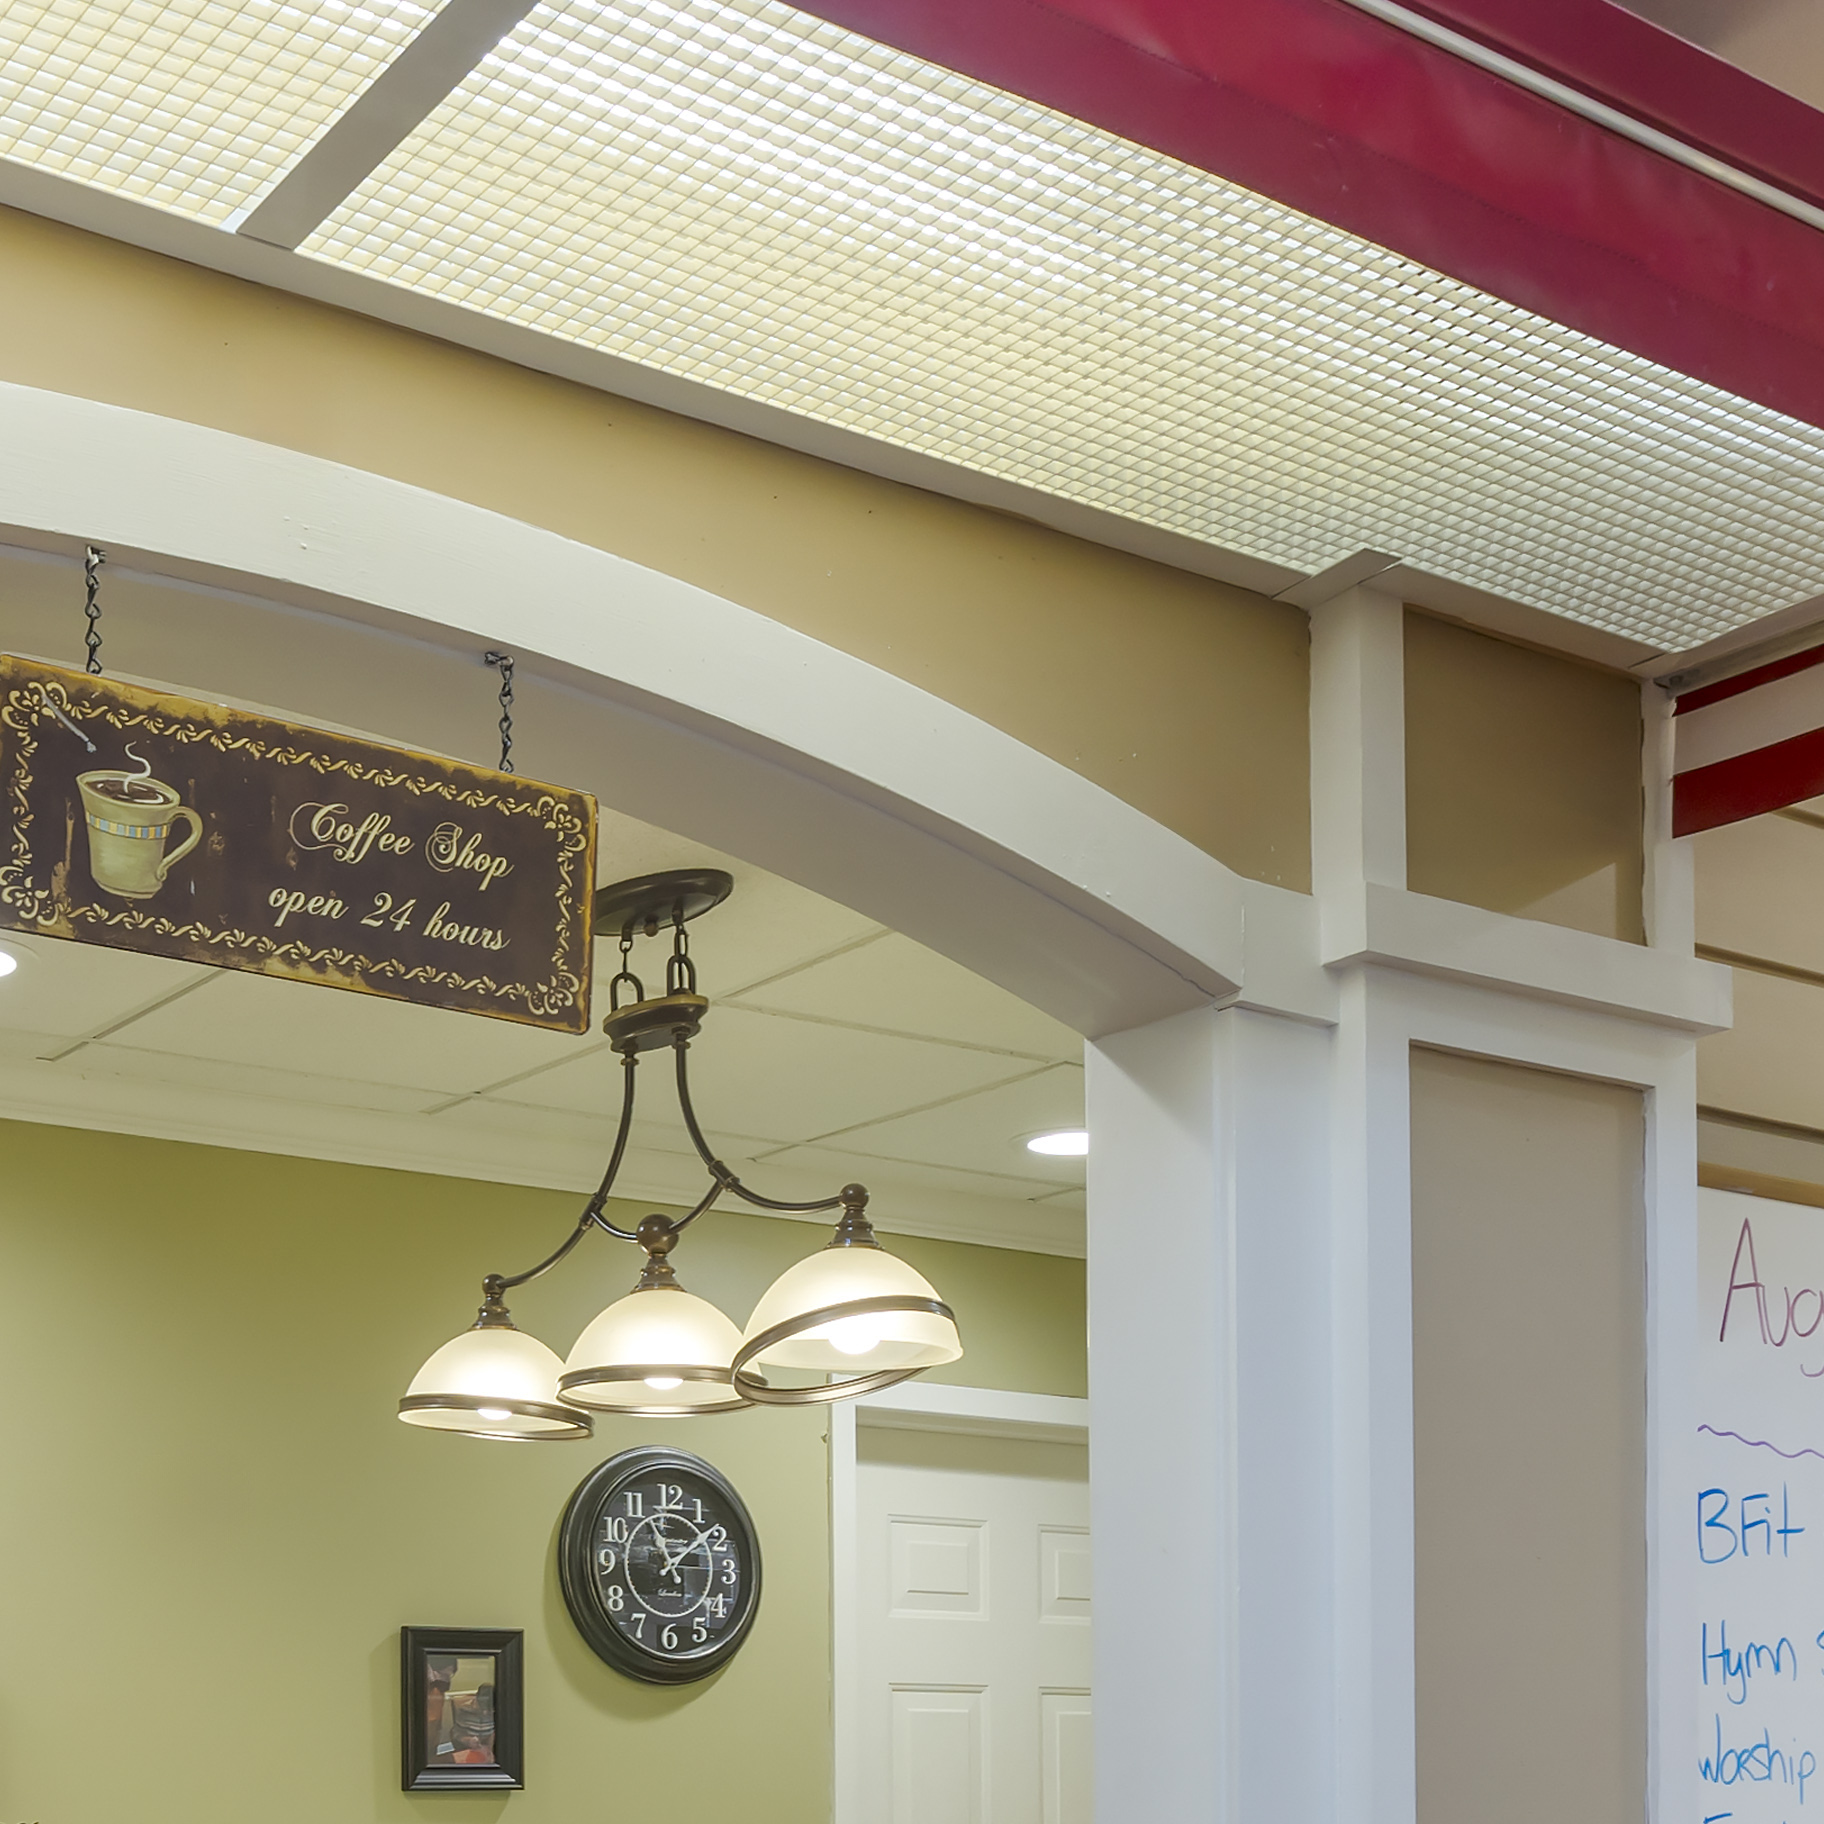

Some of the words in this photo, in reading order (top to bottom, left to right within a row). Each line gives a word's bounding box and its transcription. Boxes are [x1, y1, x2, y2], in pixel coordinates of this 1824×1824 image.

[289, 802, 414, 864] Coffee
[425, 821, 514, 891] Shop
[268, 887, 348, 930] open
[360, 892, 416, 932] 24
[422, 900, 511, 952] hours
[623, 1492, 645, 1518] 11
[657, 1484, 683, 1509] 12
[693, 1499, 705, 1523] 1
[604, 1517, 628, 1543] 10
[712, 1526, 726, 1551] 2
[600, 1549, 615, 1575] 9
[722, 1559, 736, 1584] 3
[608, 1585, 623, 1611] 8
[711, 1593, 726, 1618] 4
[631, 1613, 646, 1639] 7
[661, 1623, 677, 1649] 6
[692, 1617, 707, 1642] 5
[1703, 1620, 1797, 1704] Hymn
